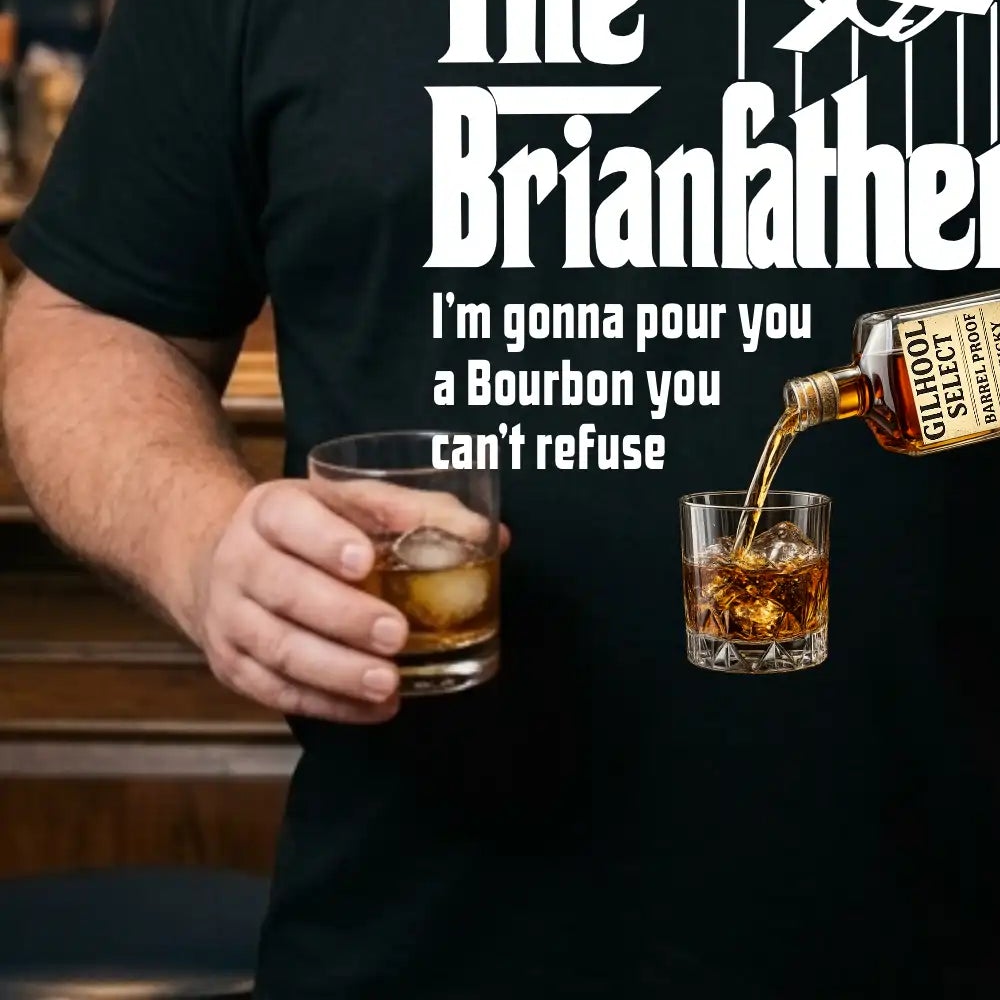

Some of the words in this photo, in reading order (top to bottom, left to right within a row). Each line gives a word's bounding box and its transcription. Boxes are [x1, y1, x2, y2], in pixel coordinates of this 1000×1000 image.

[432, 291, 491, 340] I'm
[503, 302, 624, 353] gonna
[637, 302, 727, 353] pour
[738, 303, 811, 353] you
[963, 313, 985, 364] PROOF
[433, 370, 455, 407] a
[467, 360, 634, 407] Bourbon
[646, 370, 720, 420] you
[904, 320, 946, 441] GILHOOL
[932, 333, 968, 419] SELECT
[975, 364, 998, 425] BARREL
[431, 422, 526, 470] can't
[536, 422, 666, 470] refuse
